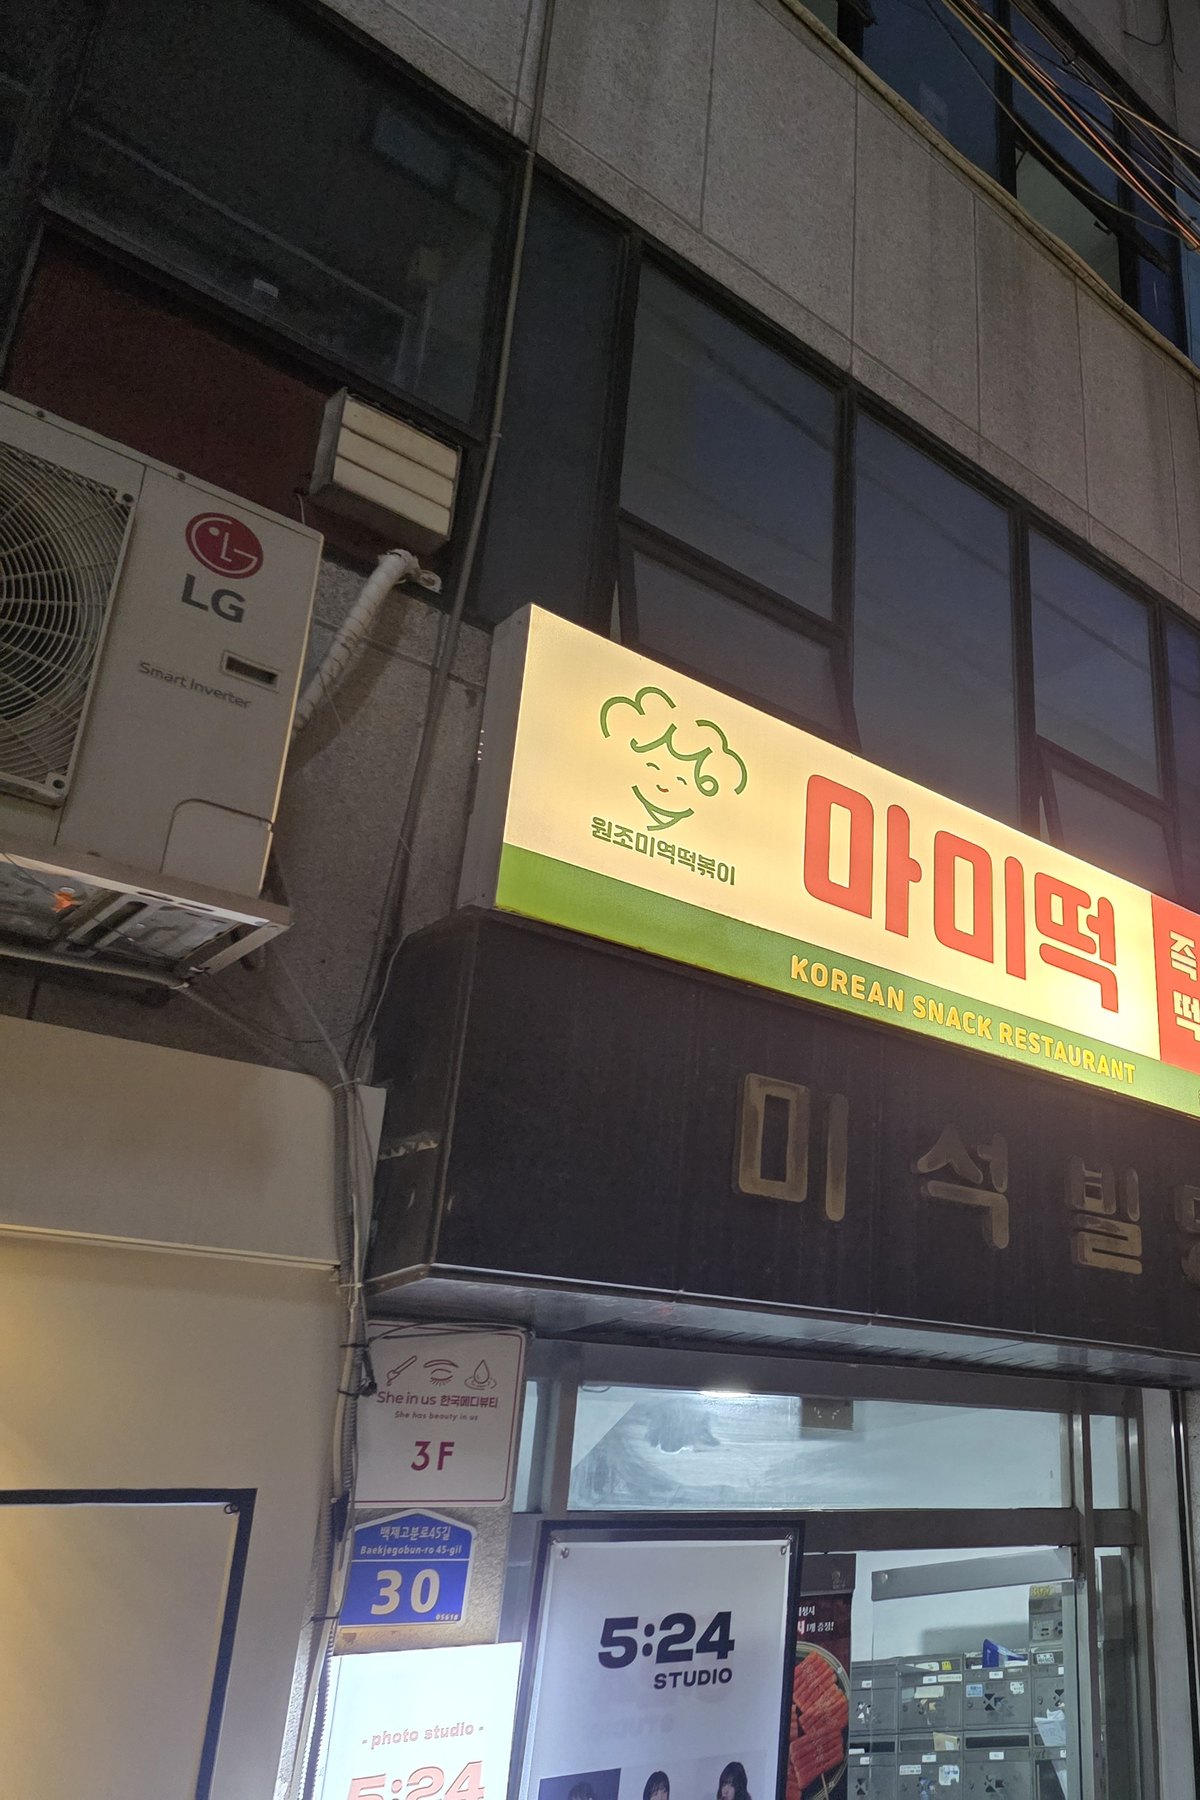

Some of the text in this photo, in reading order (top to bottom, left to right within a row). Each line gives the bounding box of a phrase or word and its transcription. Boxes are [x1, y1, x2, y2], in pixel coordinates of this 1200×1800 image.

[181, 573, 246, 623] LG
[139, 661, 253, 709] Smart Inverter
[590, 816, 736, 886] 원조미역떡볶이
[804, 773, 1118, 1013] 마미떡
[790, 954, 1136, 1086] KOREAN SNACK RESTAURANT
[377, 1391, 404, 1404] She
[420, 1395, 437, 1405] us
[395, 1411, 408, 1419] She
[412, 1411, 426, 1419] has
[429, 1411, 457, 1421] beauty
[360, 1545, 462, 1556] Baekjegobun-ro 45-gil
[380, 1526, 451, 1541] 백제고분로45길
[370, 1569, 440, 1615] 30
[598, 1611, 735, 1669] 5:24
[653, 1668, 732, 1689] STUDIO
[371, 1722, 474, 1749] photo studio
